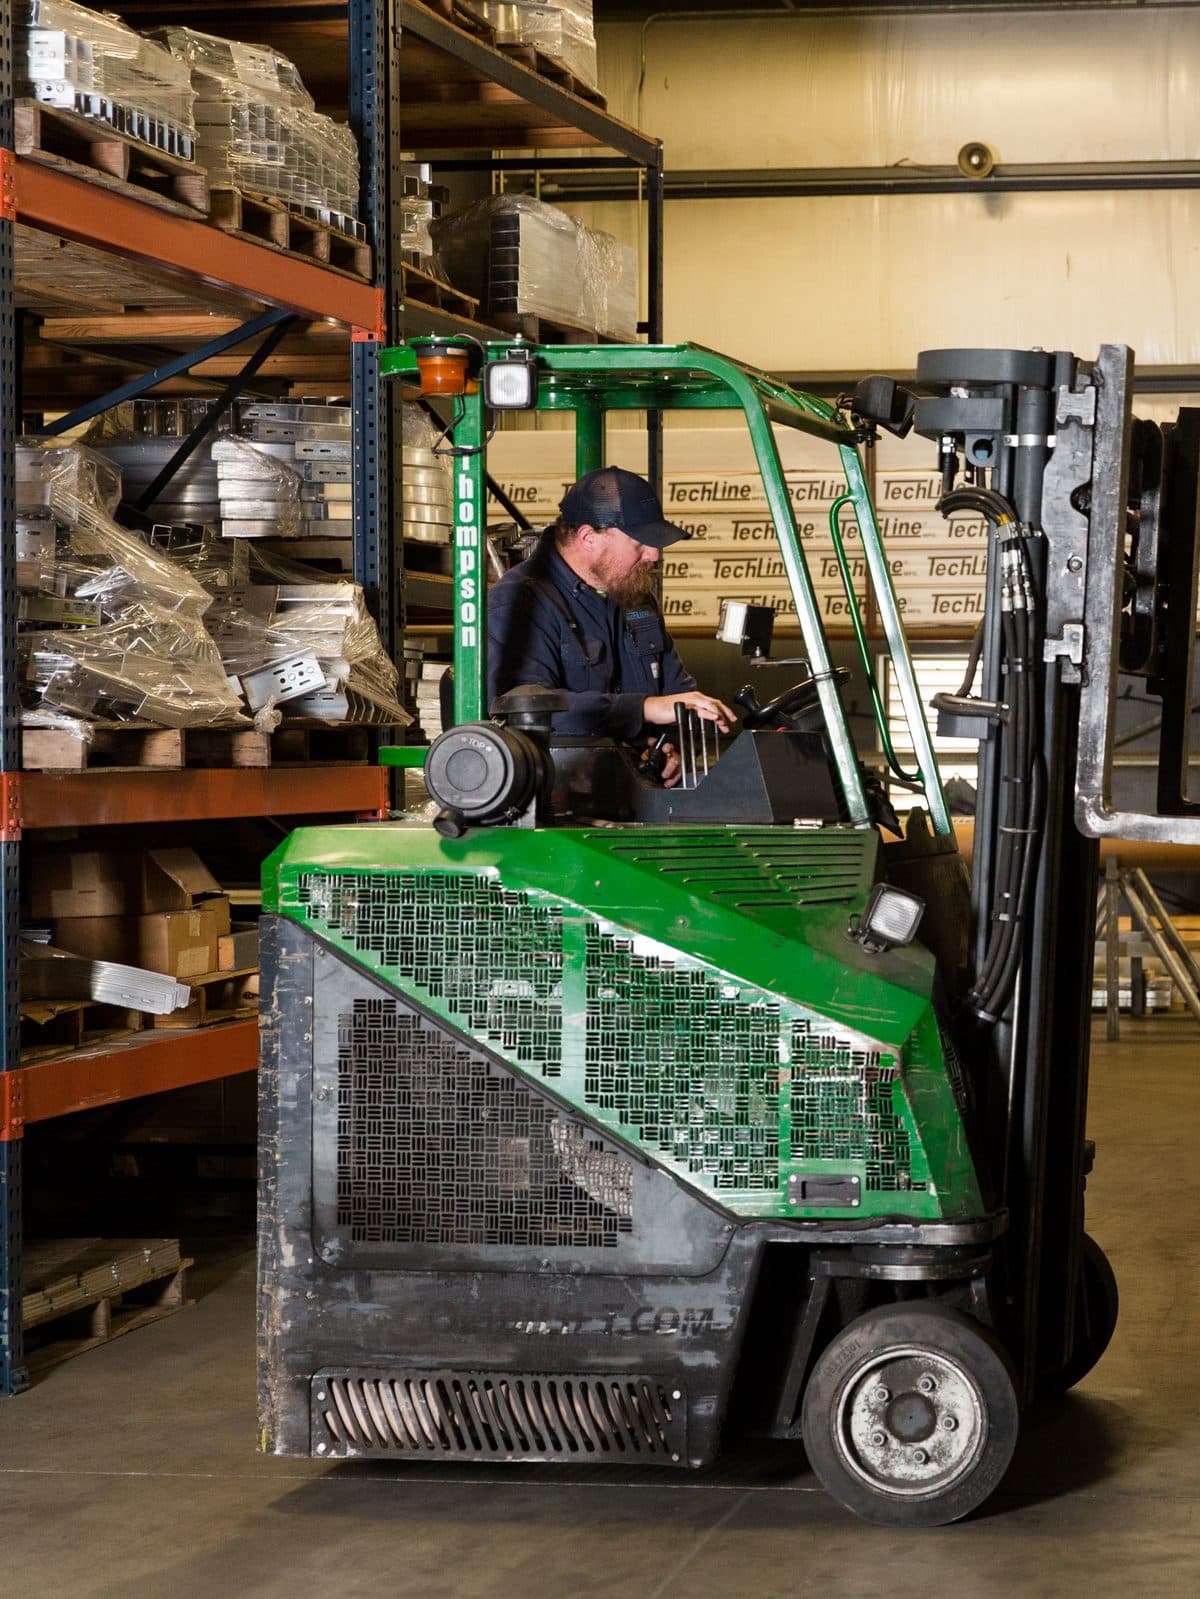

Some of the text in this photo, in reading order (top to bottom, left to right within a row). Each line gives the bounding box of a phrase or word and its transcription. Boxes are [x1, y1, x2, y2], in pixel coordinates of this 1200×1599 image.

[668, 481, 752, 502] TechLine
[786, 480, 847, 500] chLin
[839, 517, 922, 539] TeLine
[713, 557, 788, 578] TechLin
[928, 555, 987, 576] TechLi
[931, 592, 987, 614] TechL
[469, 737, 486, 749] TOP
